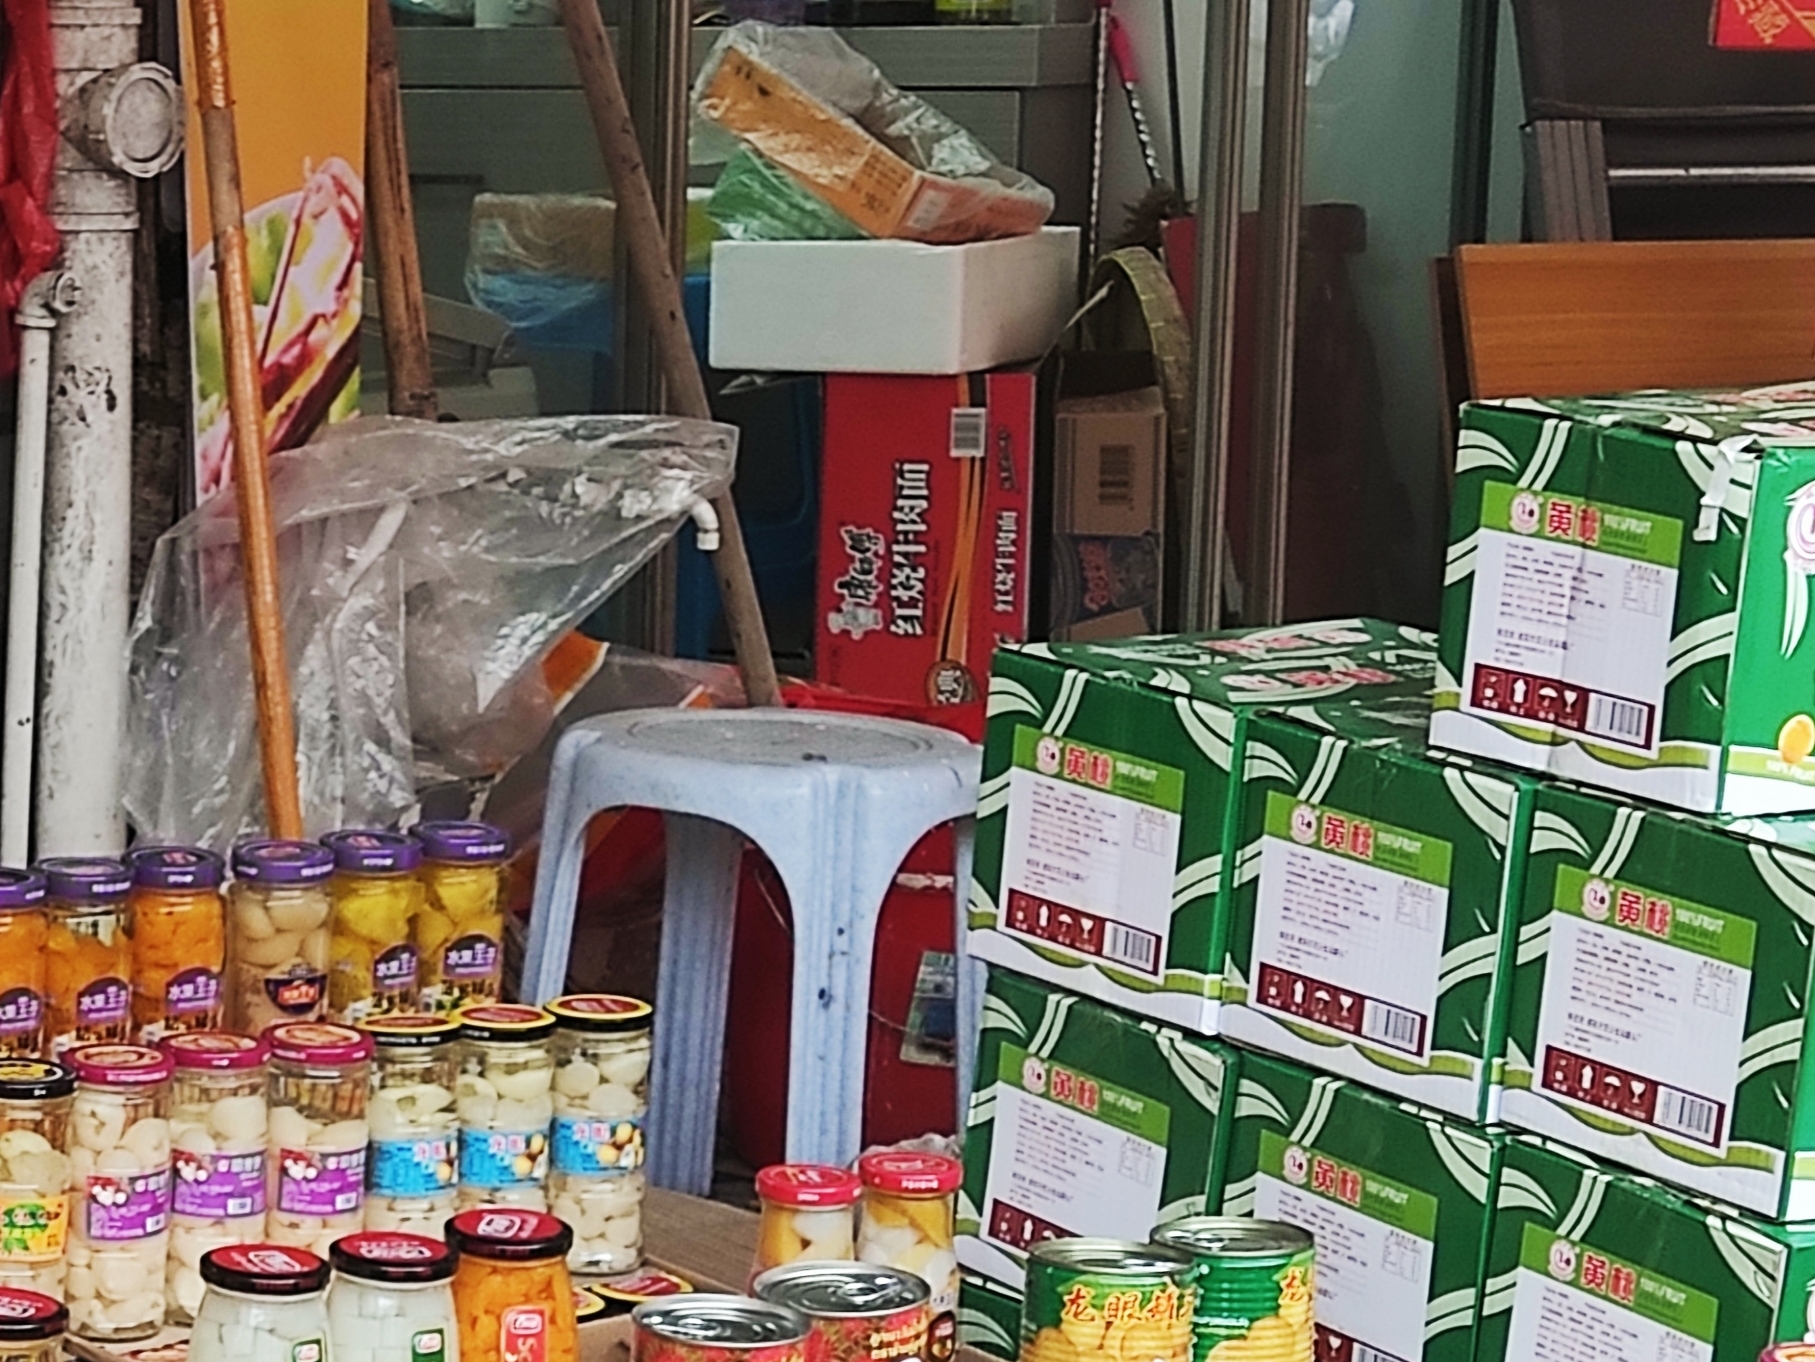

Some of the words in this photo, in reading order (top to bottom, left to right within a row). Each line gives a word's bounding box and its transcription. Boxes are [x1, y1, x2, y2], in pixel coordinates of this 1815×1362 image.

[890, 462, 930, 636] 红烧牛肉面
